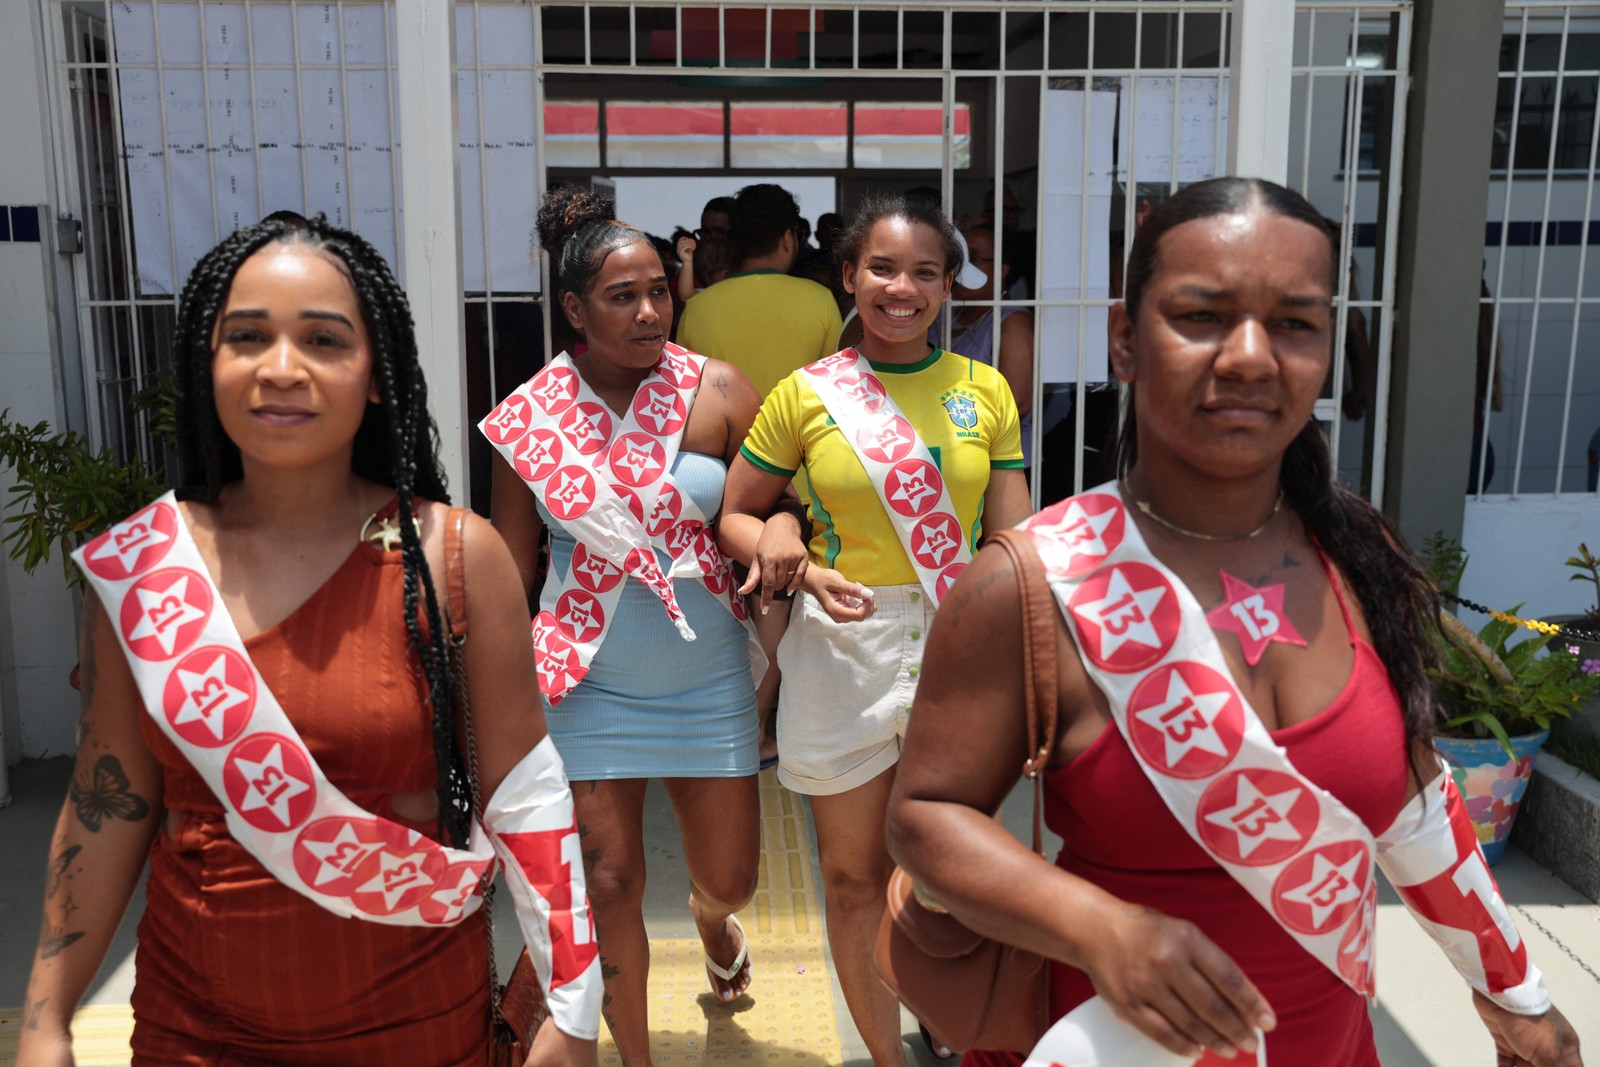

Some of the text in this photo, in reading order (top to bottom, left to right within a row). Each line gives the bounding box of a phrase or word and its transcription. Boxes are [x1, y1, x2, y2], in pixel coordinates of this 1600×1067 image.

[667, 355, 686, 372] 13
[544, 379, 563, 399] 13
[497, 408, 518, 429] 13
[650, 400, 672, 419] 13
[573, 417, 597, 439] 13
[875, 428, 899, 449] 13
[526, 443, 546, 465] 13
[626, 449, 650, 469] 13
[559, 480, 580, 503] 13
[902, 476, 927, 500] 13
[114, 522, 151, 555] 13
[677, 526, 693, 549] 13
[928, 529, 949, 553] 13
[1054, 516, 1096, 547] 13
[587, 553, 608, 575] 13
[147, 594, 185, 634] 13
[570, 608, 589, 630] 13
[1097, 592, 1147, 636] 13
[1229, 593, 1280, 642] 13
[543, 655, 565, 676] 13
[190, 676, 229, 718] 13
[1159, 694, 1209, 744] 13
[251, 765, 290, 806] 13
[1230, 797, 1283, 837] 13
[324, 841, 368, 874] 13
[383, 860, 418, 893] 13
[1306, 869, 1351, 908] 13
